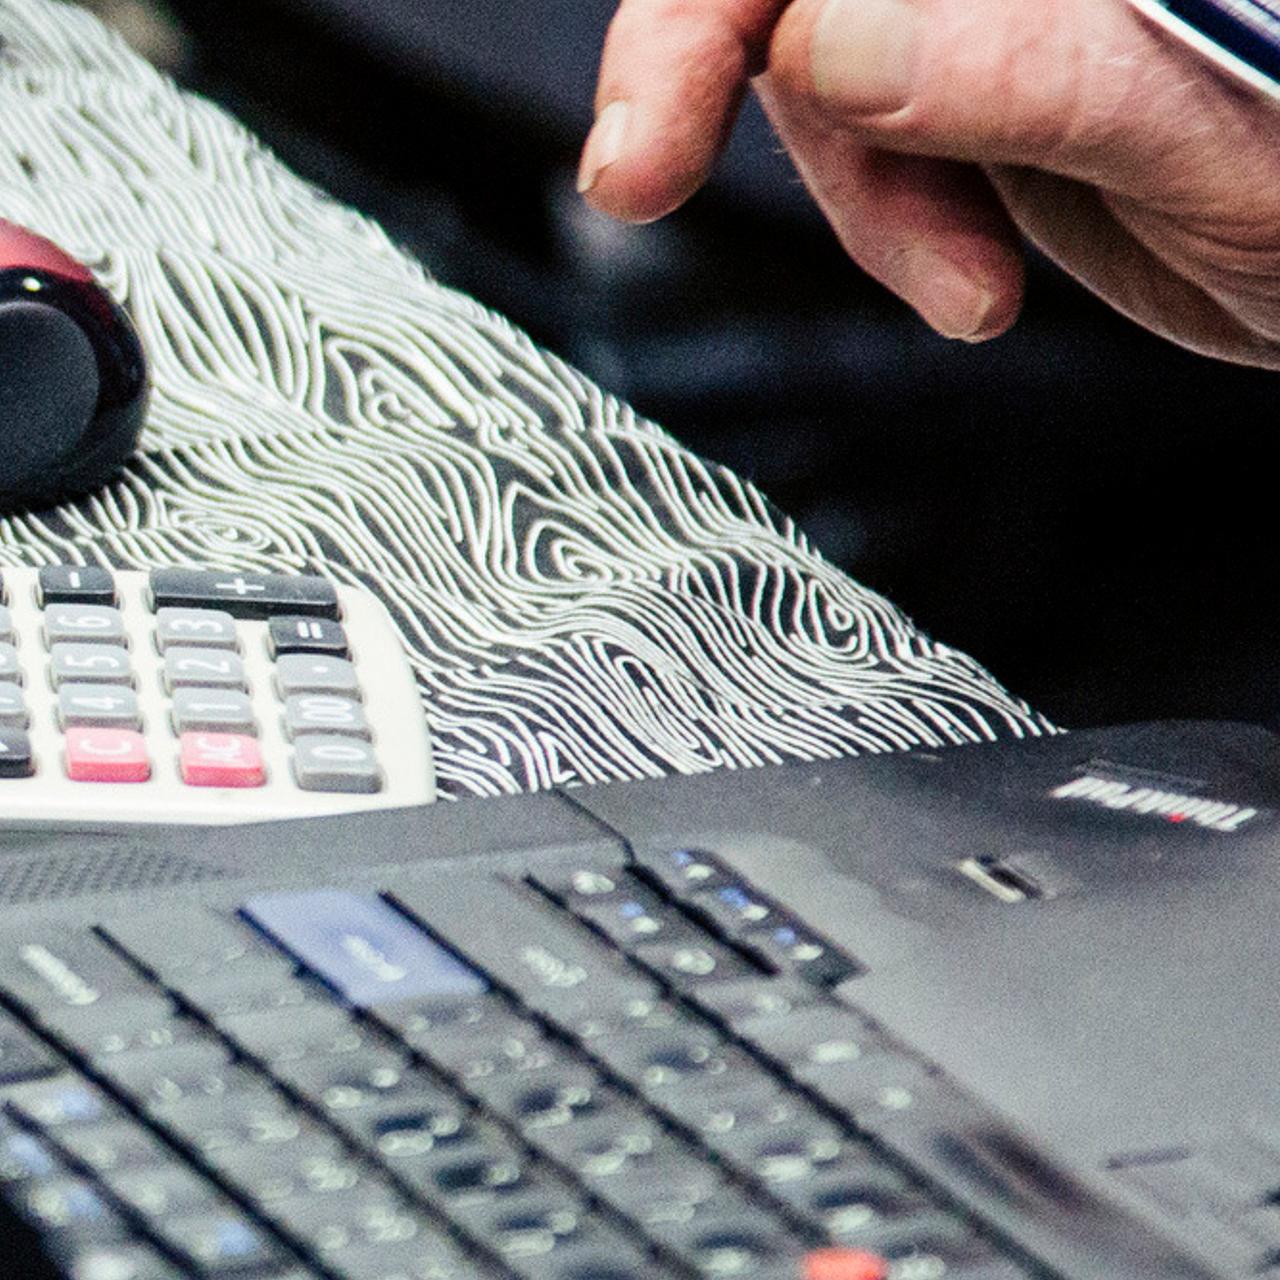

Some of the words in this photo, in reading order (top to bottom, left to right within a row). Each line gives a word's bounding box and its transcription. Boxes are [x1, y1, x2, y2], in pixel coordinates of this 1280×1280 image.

[215, 578, 265, 594] +
[57, 614, 112, 628] 6
[170, 619, 223, 634] 3
[296, 621, 324, 639] =
[66, 655, 120, 668] 5
[177, 658, 231, 673] 2
[71, 696, 126, 710] 4
[187, 702, 241, 712] 1
[298, 698, 355, 723] 00
[79, 740, 133, 755] C
[196, 736, 241, 761] AC
[310, 746, 367, 761] 0
